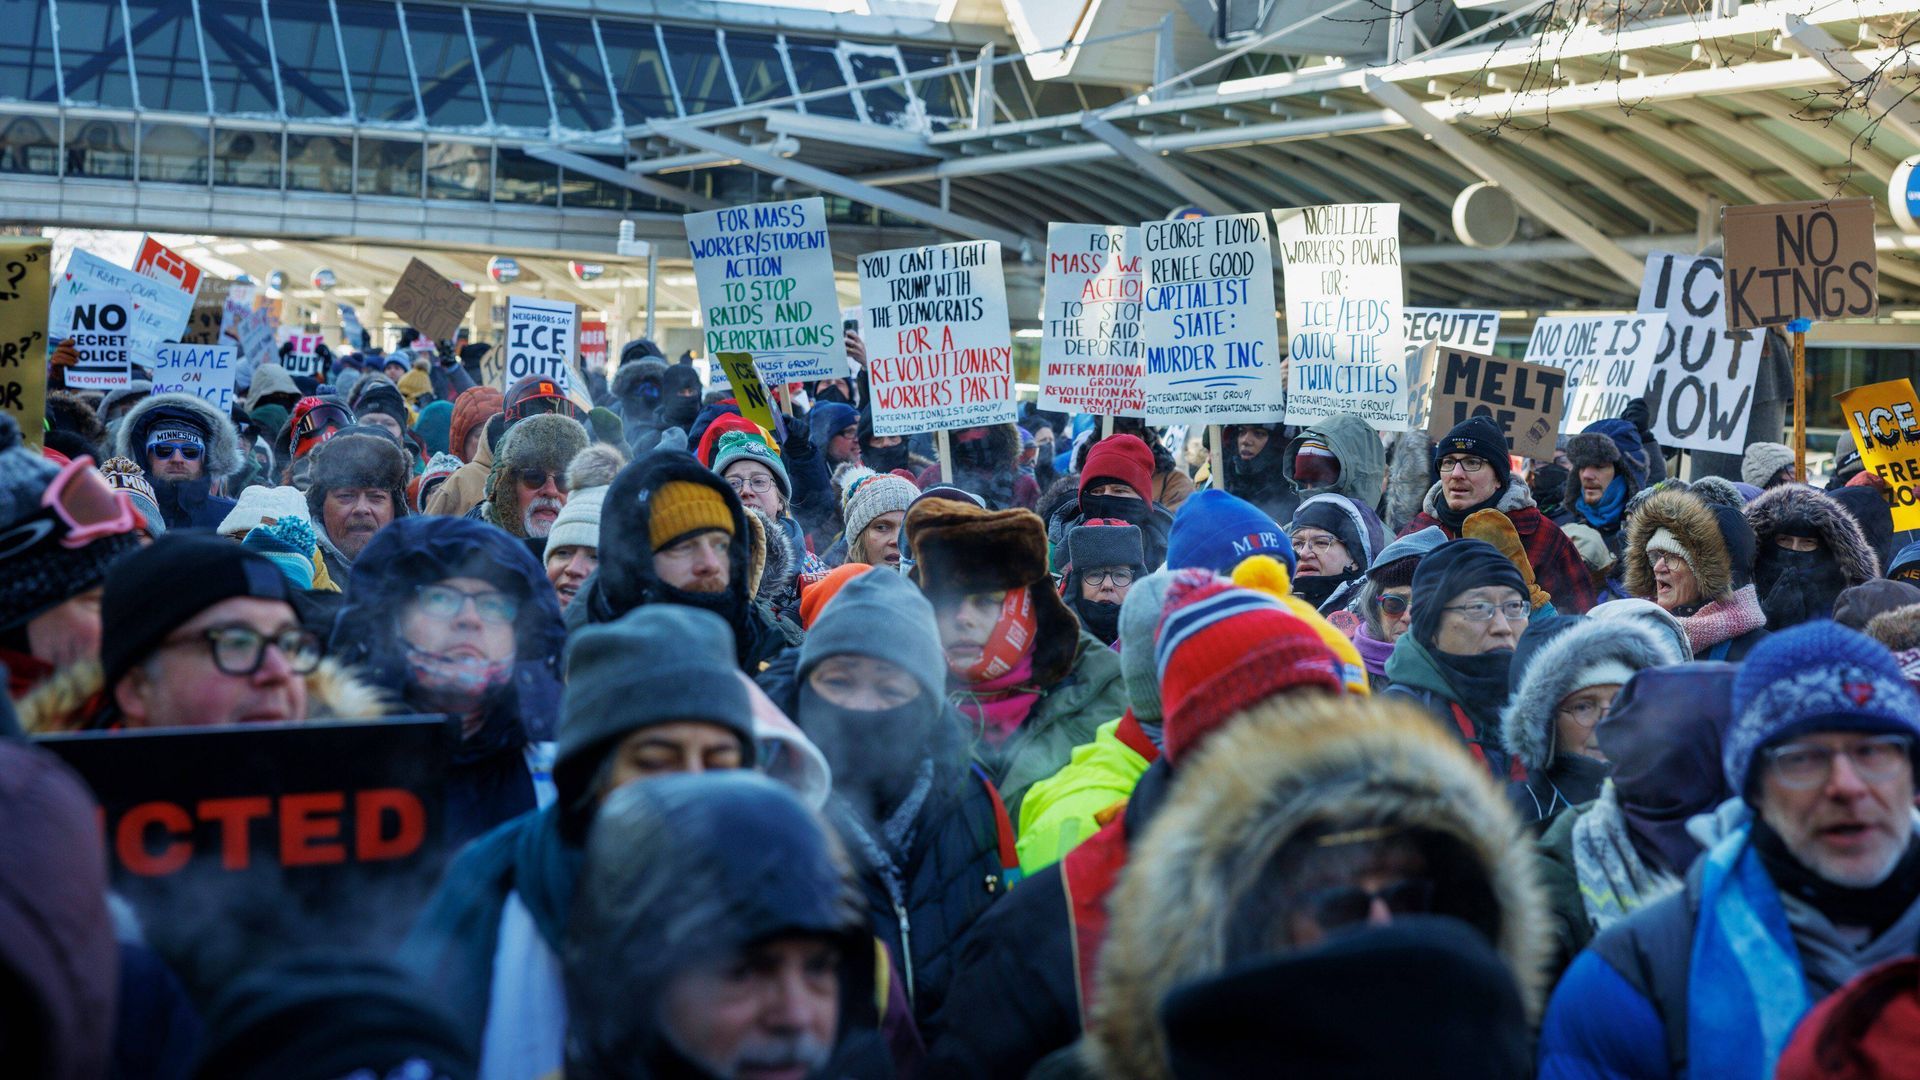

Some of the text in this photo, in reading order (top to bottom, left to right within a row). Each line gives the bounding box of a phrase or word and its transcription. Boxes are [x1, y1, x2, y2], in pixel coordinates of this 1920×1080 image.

[717, 204, 805, 232] FOR MASS
[1302, 206, 1378, 236] MOBILIZE
[690, 230, 827, 260] WORKER/STUDENT
[1090, 234, 1123, 252] FOR
[1146, 218, 1266, 251] GEORGE FLOYD,
[1776, 212, 1838, 267] NO
[862, 242, 989, 278] YOU CAN'T FIGHT
[1051, 253, 1102, 274] MASS
[1283, 237, 1398, 266] WORKERS POWER
[725, 256, 782, 279] ACTION
[1152, 251, 1254, 284] RENEE GOOD
[721, 277, 797, 303] TO STOP
[888, 270, 971, 302] TRUMP WITH
[1082, 279, 1142, 300] ACTIO
[1146, 278, 1250, 312] CAPITALIST
[1321, 269, 1350, 295] FOR:
[1654, 254, 1724, 318] IC
[1729, 261, 1874, 328] KINGS
[72, 304, 127, 331] NO
[512, 313, 571, 325] NEIGHBORS SAY
[709, 301, 812, 327] RAIDS AND
[869, 297, 984, 328] THE DEMOCRATS
[1062, 302, 1083, 318] TO
[1301, 297, 1390, 335] ICE/FEDS
[1050, 319, 1145, 339] THE RAID
[1174, 310, 1236, 340] STATE:
[1530, 319, 1646, 356] NO ONE IS
[512, 324, 567, 355] ICE
[706, 324, 834, 354] DEPORTATIONS
[898, 325, 954, 354] FOR A
[1348, 333, 1382, 364] THE
[78, 350, 127, 362] OLICE
[157, 349, 230, 368] SHAME
[788, 358, 819, 369] GROUP/
[870, 346, 1012, 386] REVOLUTIONARY
[1148, 341, 1271, 375] MURDER INC.
[84, 376, 102, 384] OUT
[104, 376, 127, 384] NOW
[182, 372, 202, 382] ON
[1048, 363, 1145, 377] INTERNATIONA
[1089, 377, 1136, 388] GROUP/
[1295, 363, 1332, 391] TWIN
[1335, 364, 1398, 394] CITIES
[1443, 352, 1566, 414] MELT
[1607, 360, 1635, 387] ON
[877, 375, 1011, 409] WORKERS PARTY
[1045, 385, 1146, 399] REVOLUTIONARY
[1059, 397, 1146, 411] INTERNATION
[1147, 389, 1252, 402] INTERNATIONALIST GROUP/
[1288, 394, 1394, 414] INTERNATIONALIST GROUP/
[875, 402, 1003, 422] INTERNATIONALIST GROUP/
[993, 412, 1016, 423] YOUTH
[1083, 406, 1121, 415] YOUTH
[1147, 405, 1202, 415] REVOLUTIONARY
[1204, 404, 1266, 414] INTERNATIONALIST
[156, 431, 200, 443] MINNESOTA
[1853, 402, 1920, 452] ICE
[1884, 484, 1918, 509] ZO
